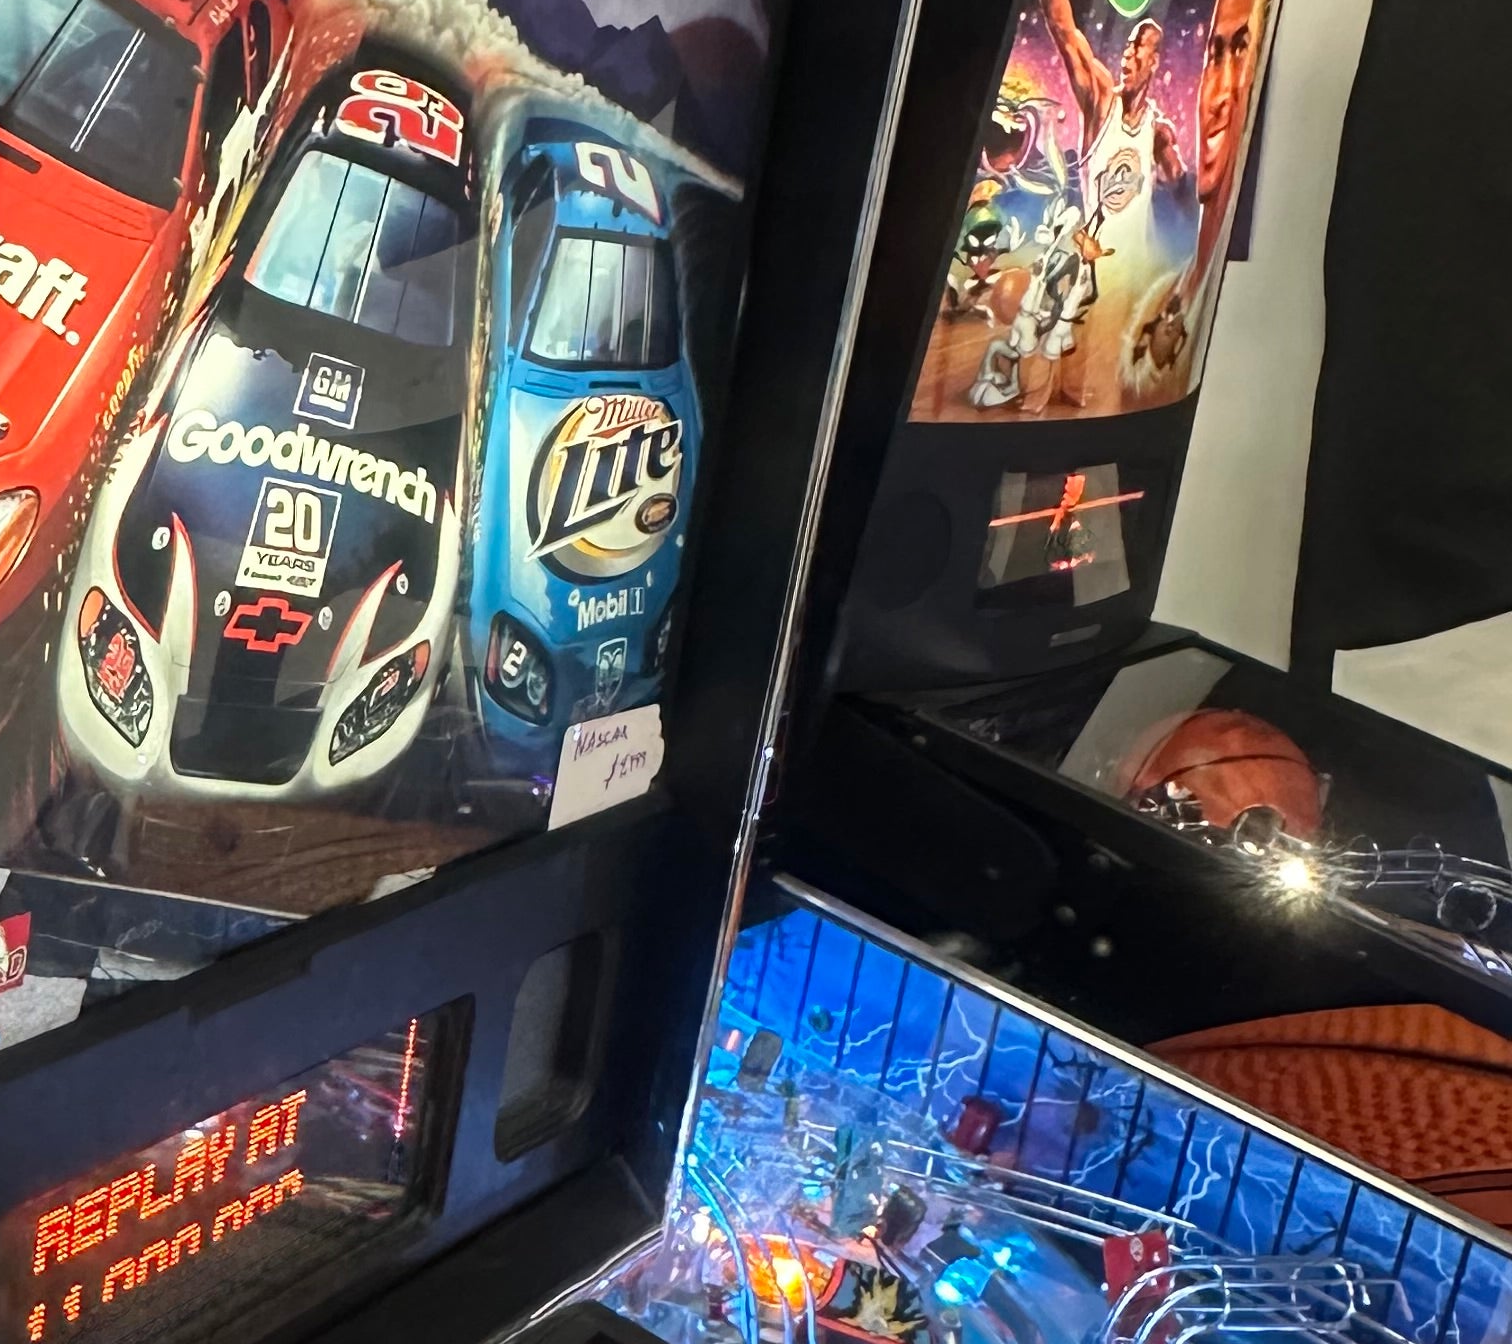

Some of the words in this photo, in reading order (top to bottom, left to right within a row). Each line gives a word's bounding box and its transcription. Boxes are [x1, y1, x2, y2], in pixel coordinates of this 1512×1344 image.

[336, 69, 465, 167] 29
[574, 141, 661, 224] 2
[311, 365, 352, 403] GM
[585, 396, 660, 430] Miller
[167, 407, 438, 525] Goodwrench
[525, 419, 683, 561] Lite
[264, 487, 322, 553] 20
[256, 550, 317, 574] YEARS
[576, 588, 629, 632] Mobil
[502, 640, 528, 677] 2
[573, 725, 629, 762] NASCAR
[32, 1122, 237, 1276] REPLAY
[245, 1087, 308, 1166] AT
